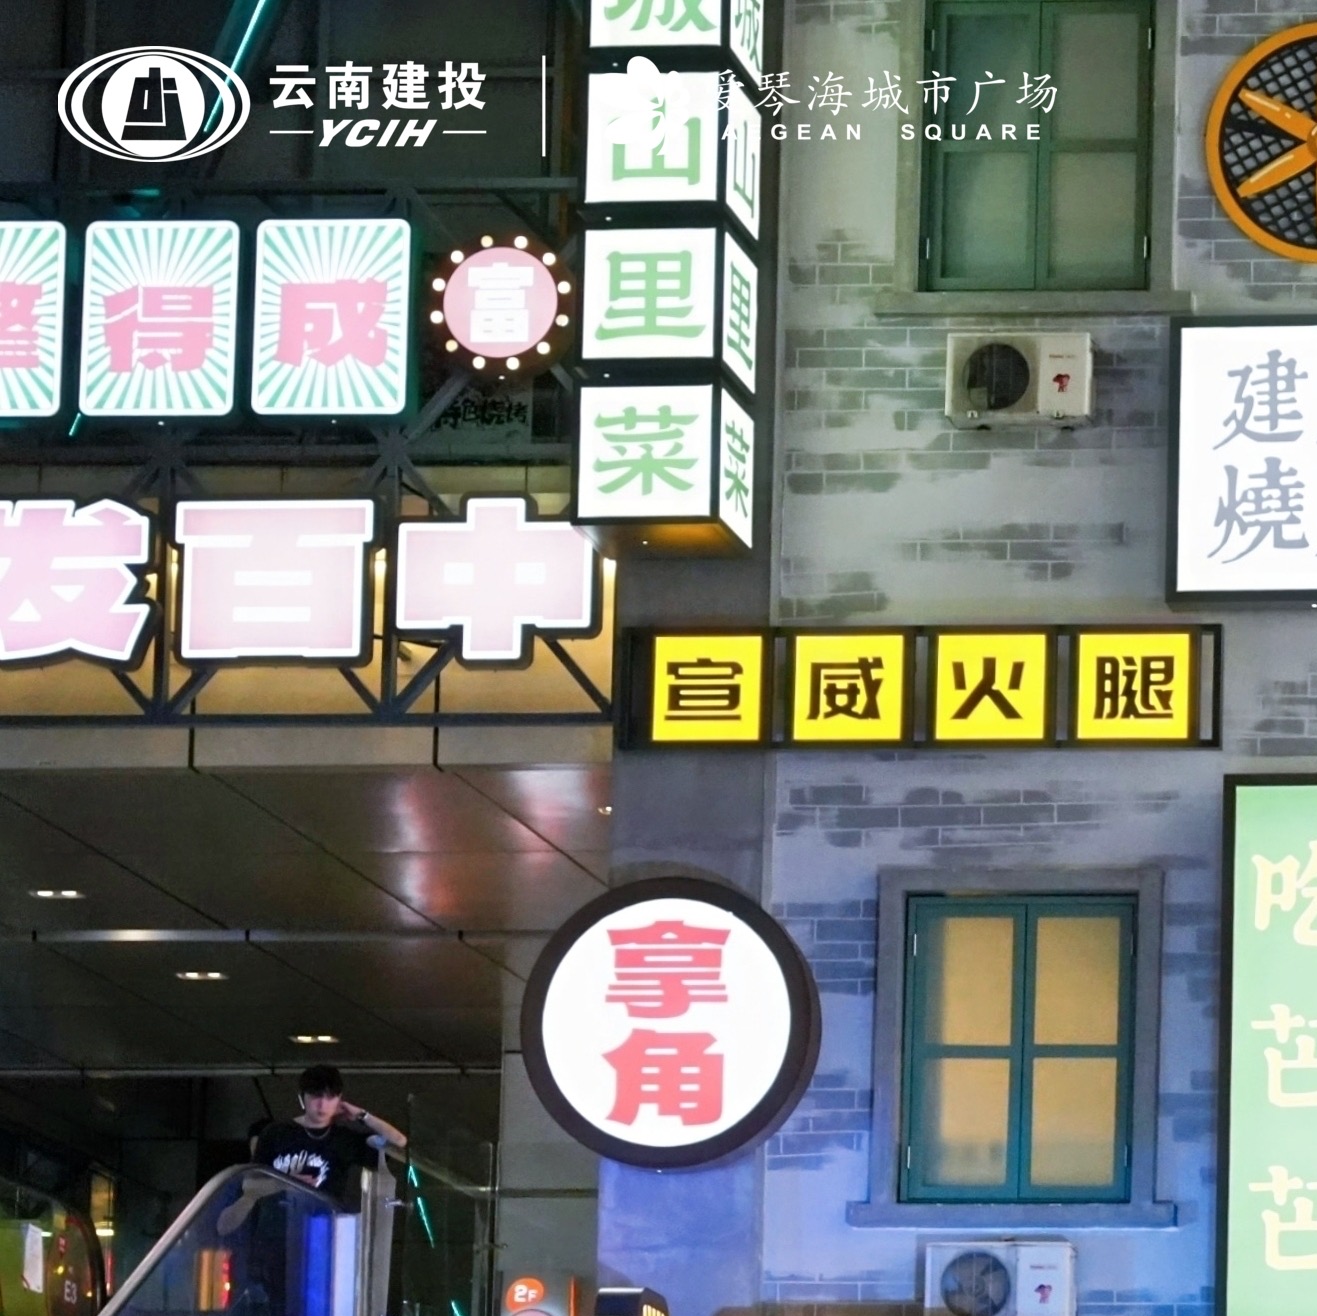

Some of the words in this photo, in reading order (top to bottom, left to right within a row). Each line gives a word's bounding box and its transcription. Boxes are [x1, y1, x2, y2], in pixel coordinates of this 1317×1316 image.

[466, 261, 530, 346] 富
[664, 656, 1176, 722] 宣威火腿
[602, 919, 732, 1127] 拿角
[513, 1284, 538, 1302] 2F
